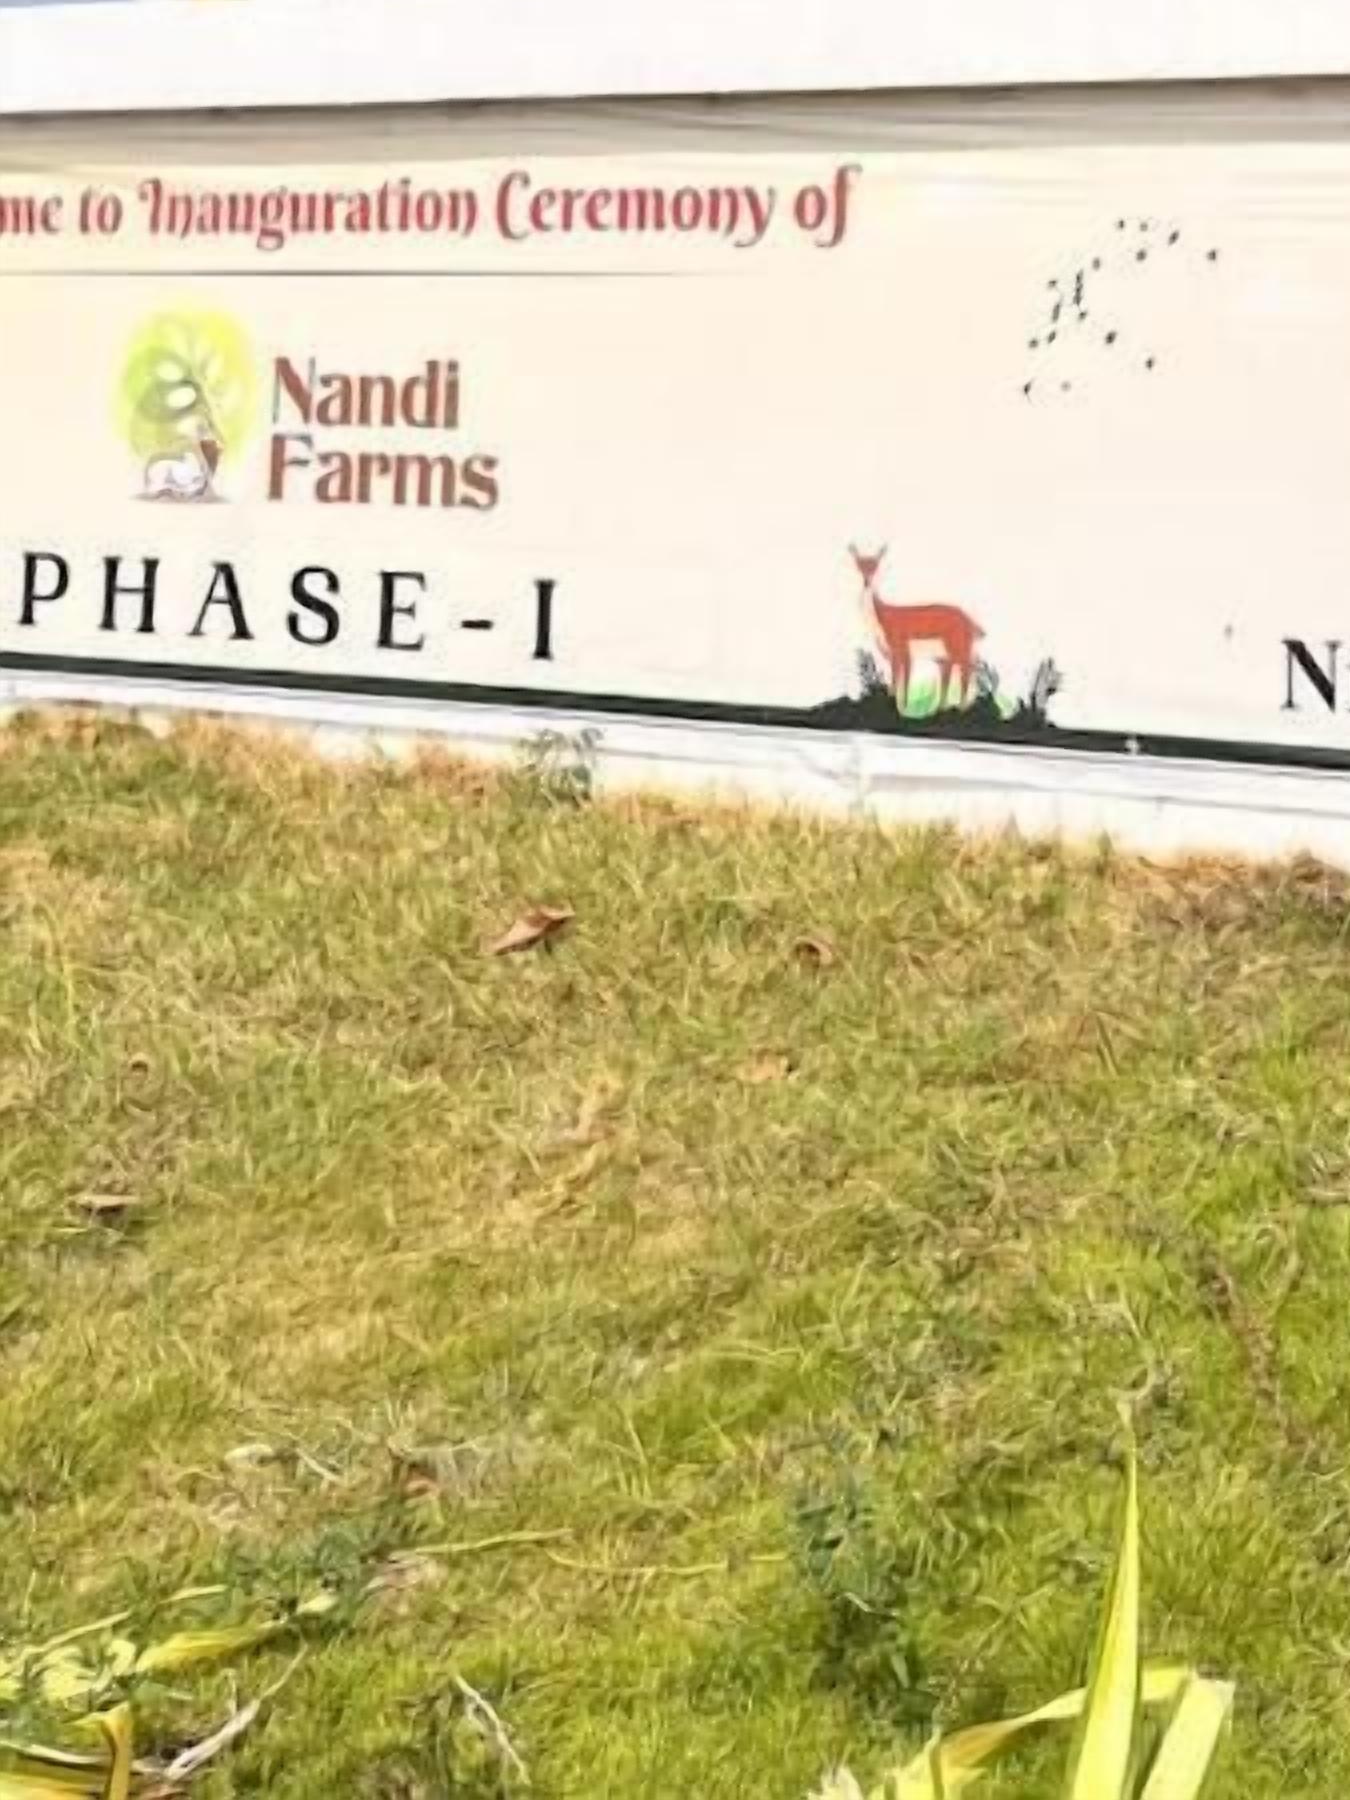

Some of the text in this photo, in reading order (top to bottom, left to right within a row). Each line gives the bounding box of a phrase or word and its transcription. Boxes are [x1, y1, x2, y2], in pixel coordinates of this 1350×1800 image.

[78, 186, 123, 235] to
[137, 176, 479, 251] Inauguration
[495, 171, 776, 248] Ceremony
[793, 164, 862, 248] of
[272, 355, 460, 431] Nandi
[266, 433, 500, 511] Farms
[17, 550, 557, 662] PHASE-I
